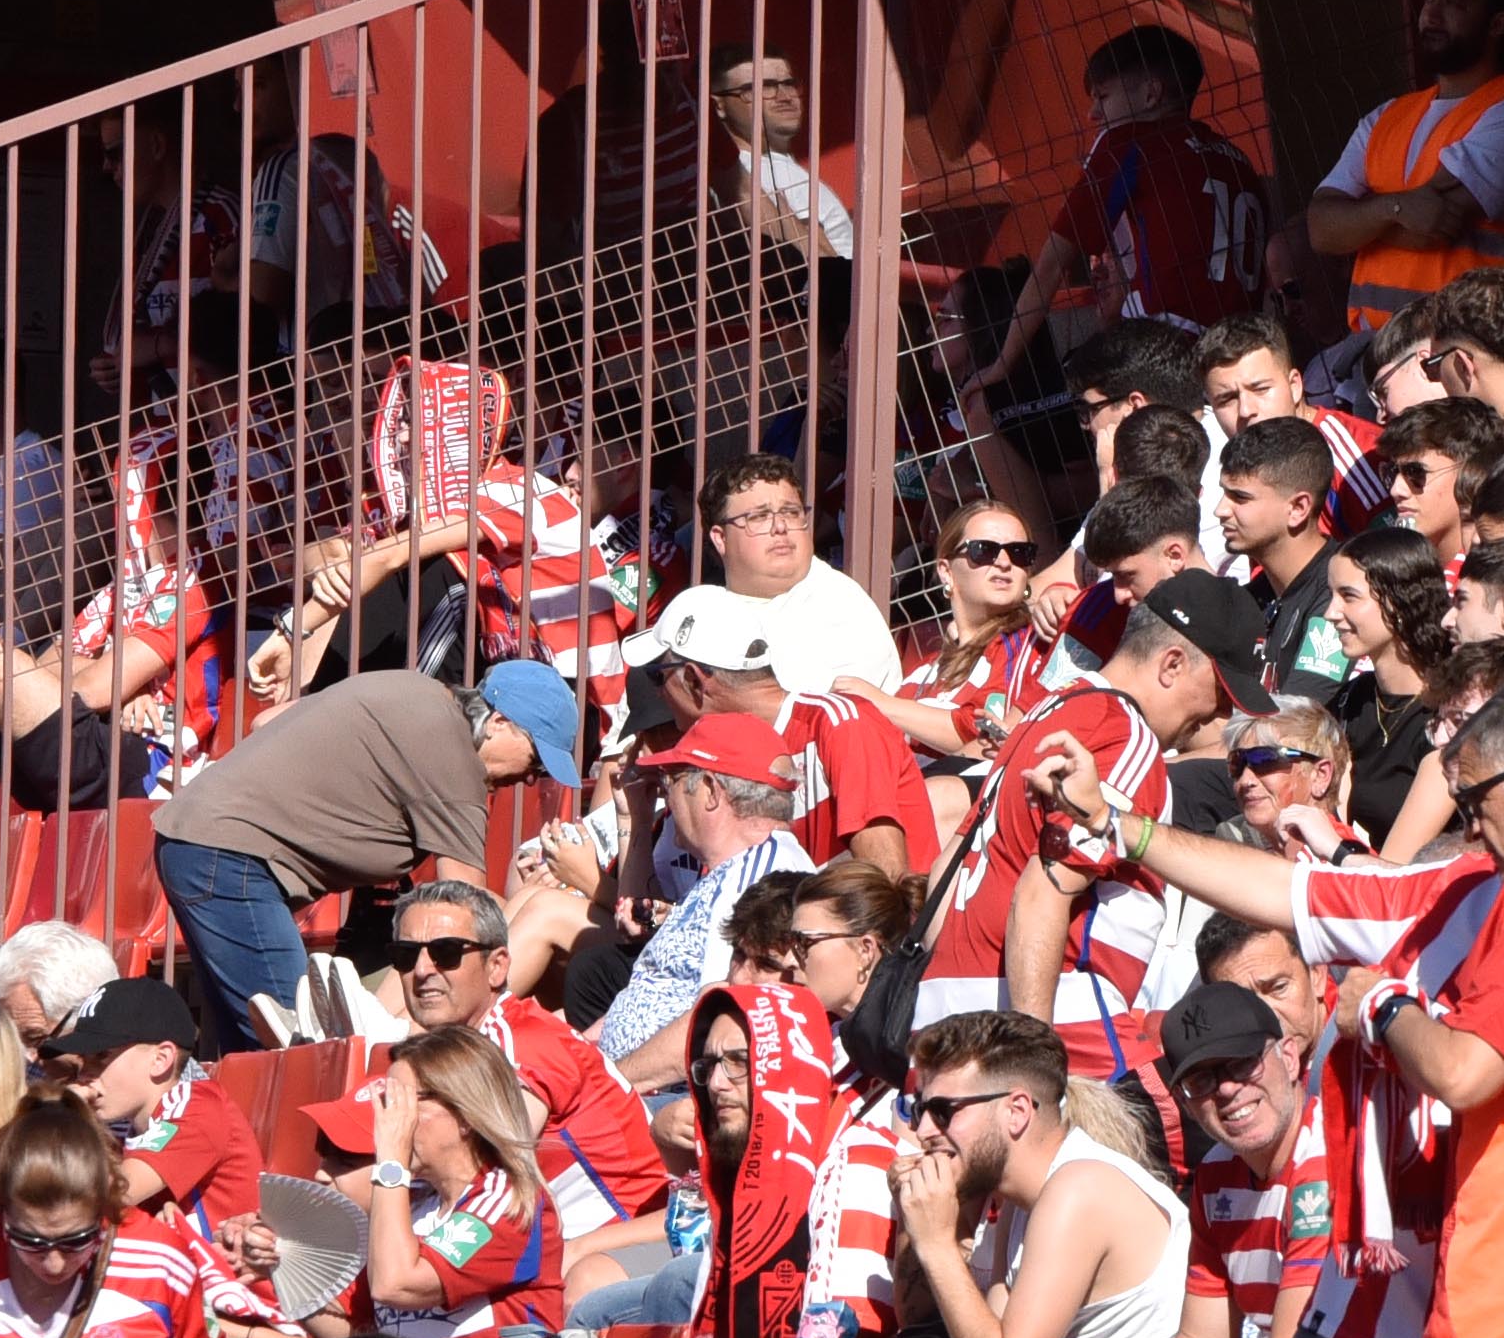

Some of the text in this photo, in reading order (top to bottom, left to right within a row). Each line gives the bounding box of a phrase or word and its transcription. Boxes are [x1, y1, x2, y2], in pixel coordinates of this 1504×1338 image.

[1201, 177, 1267, 293] 10
[748, 996, 771, 1087] PASITO
[745, 1112, 765, 1180] 2018/19
